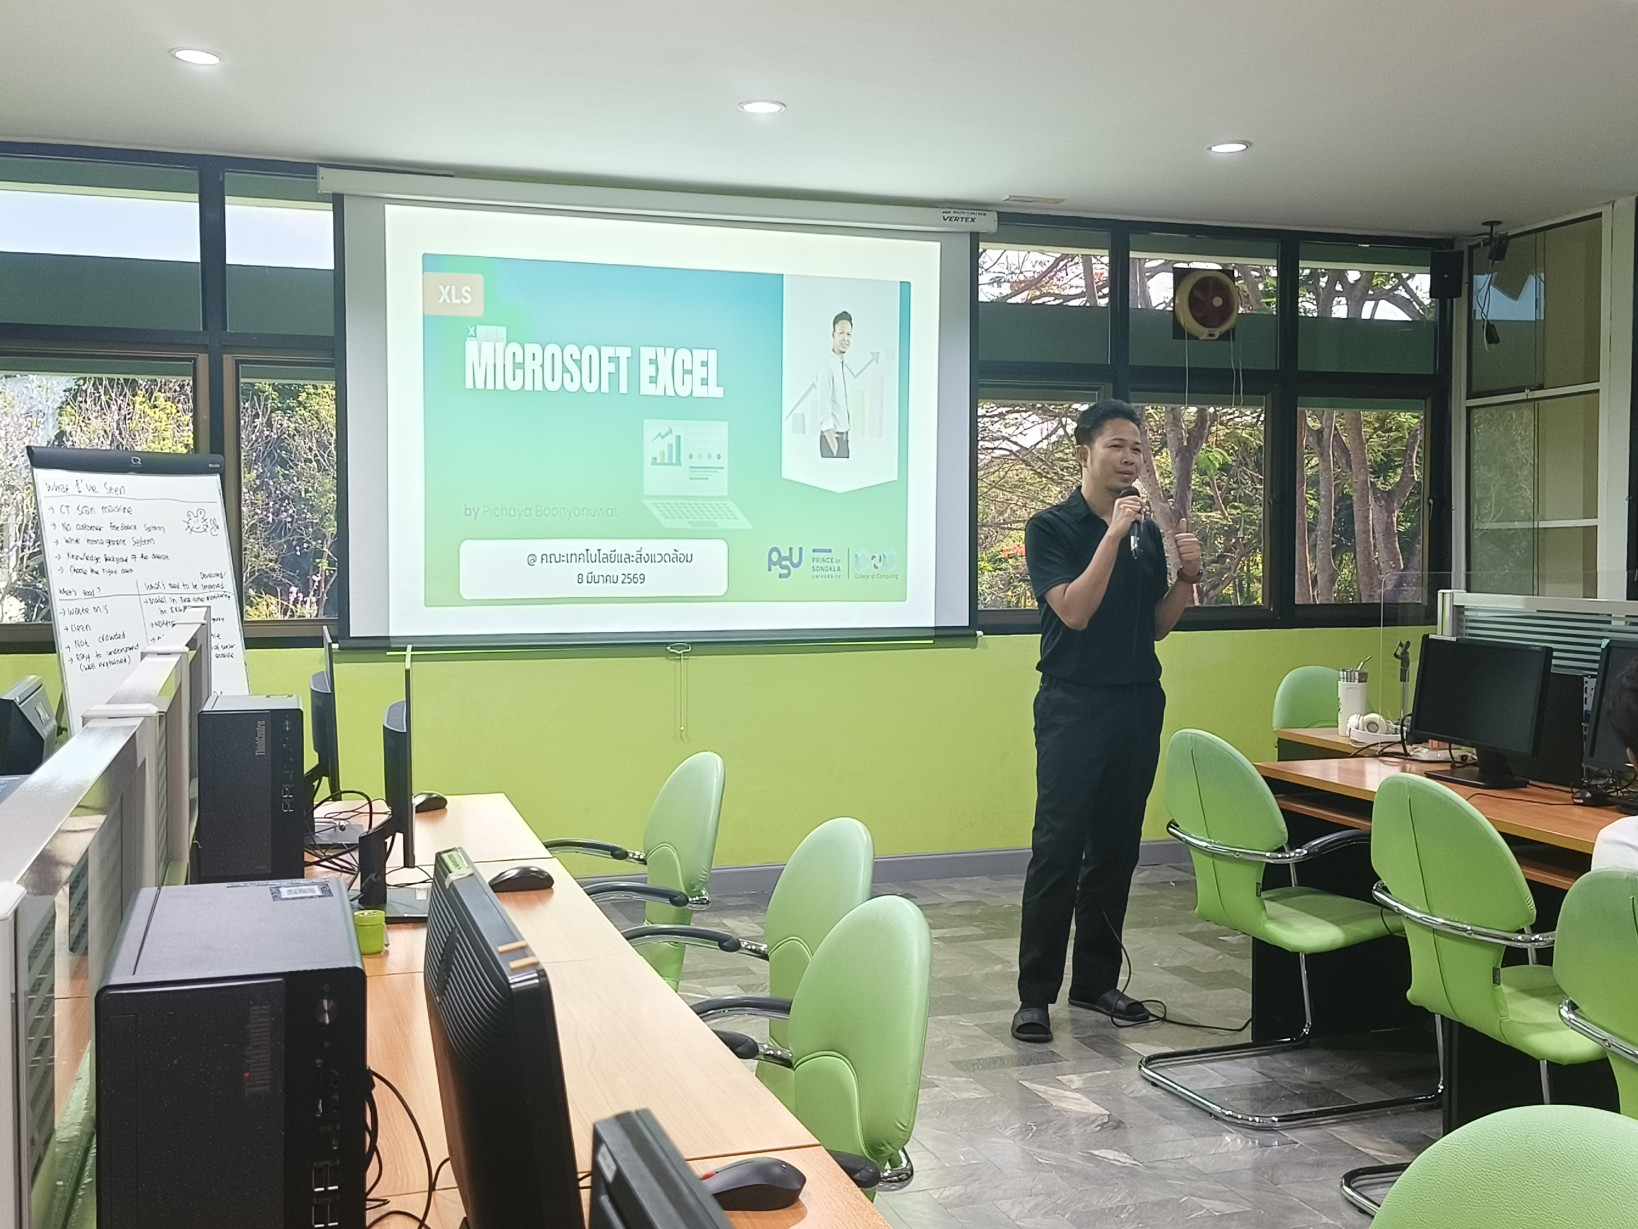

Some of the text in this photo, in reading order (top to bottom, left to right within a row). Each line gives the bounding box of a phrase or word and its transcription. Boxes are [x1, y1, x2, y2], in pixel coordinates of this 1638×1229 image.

[942, 215, 977, 223] VERTEX
[438, 284, 473, 305] XLS
[465, 339, 724, 398] MICROSOFT EXCEL
[60, 504, 70, 515] CT
[463, 504, 480, 521] by
[482, 505, 532, 521] Pichaya
[526, 547, 693, 567] @ คณะเทคโนโลยีและสิ่งแวดล้อม
[576, 571, 646, 585] 8 มีนาคม 2569
[255, 720, 266, 756] ThinkCentre
